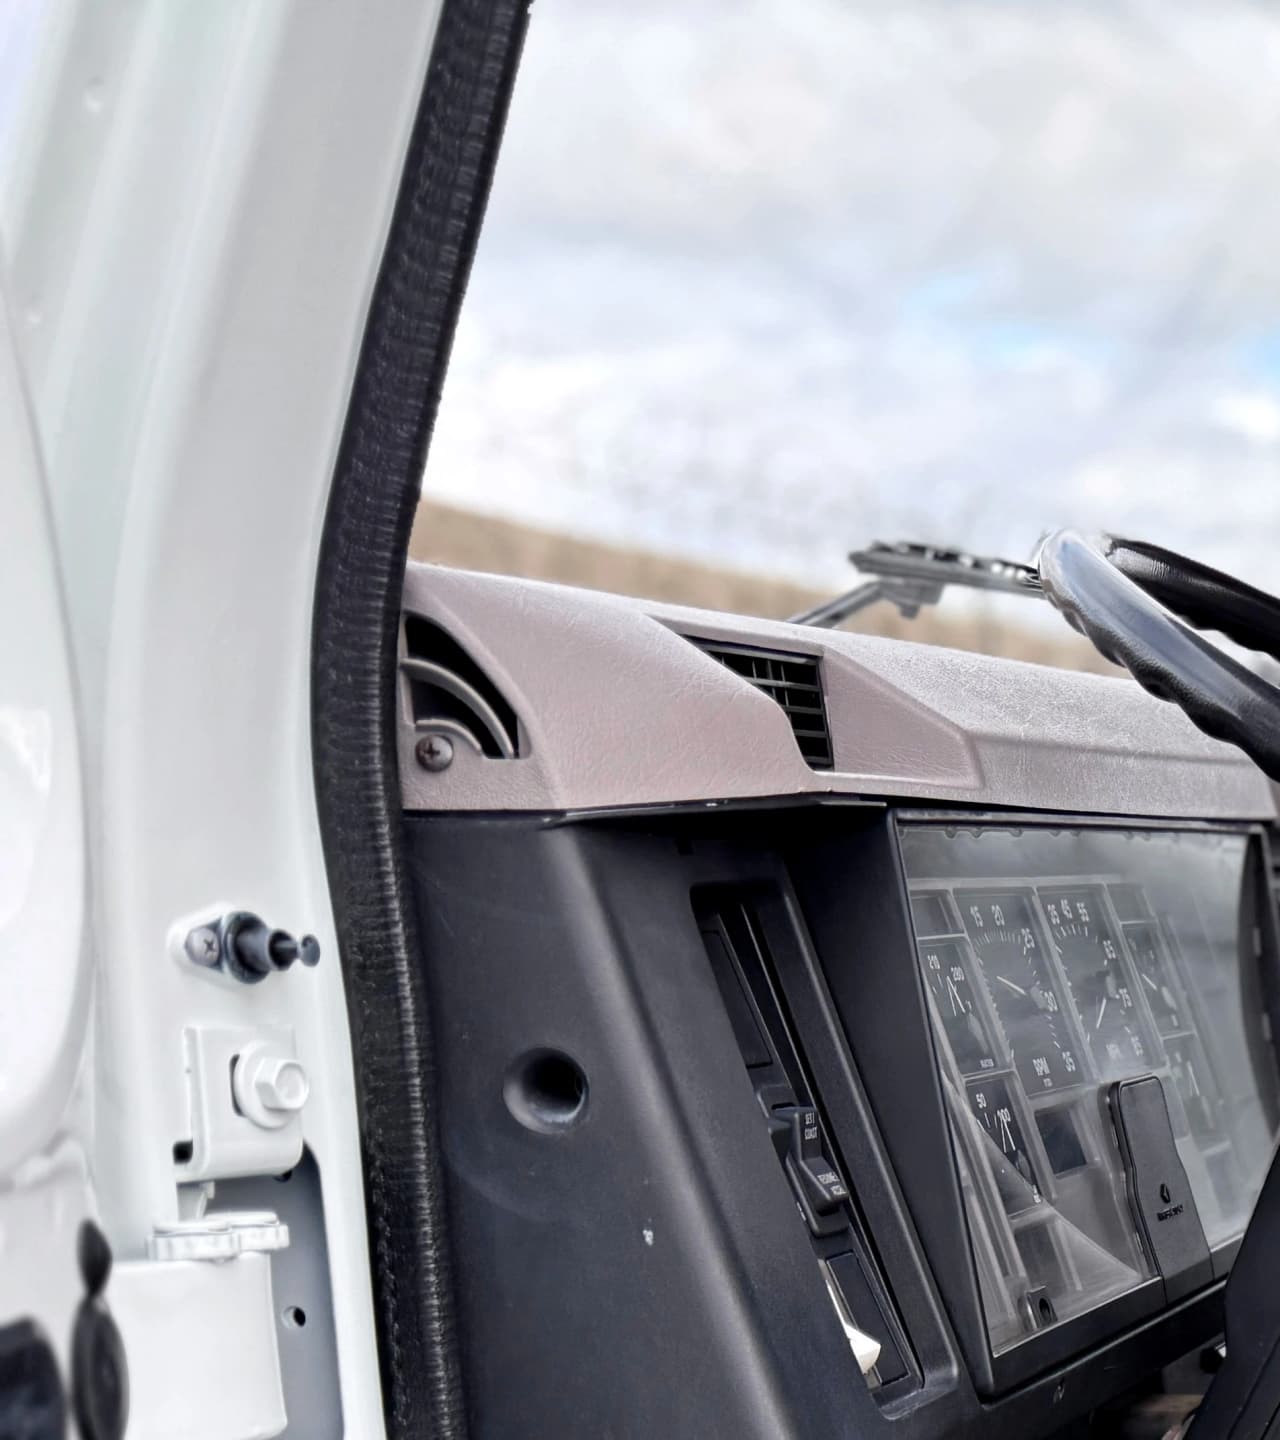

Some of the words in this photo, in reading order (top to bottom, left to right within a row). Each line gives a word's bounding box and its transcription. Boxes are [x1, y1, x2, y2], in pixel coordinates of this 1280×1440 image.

[970, 906, 984, 928] 15
[991, 905, 1005, 926] 20
[1076, 902, 1090, 923] 55
[1021, 928, 1035, 948] 25
[1032, 1057, 1050, 1077] RPM
